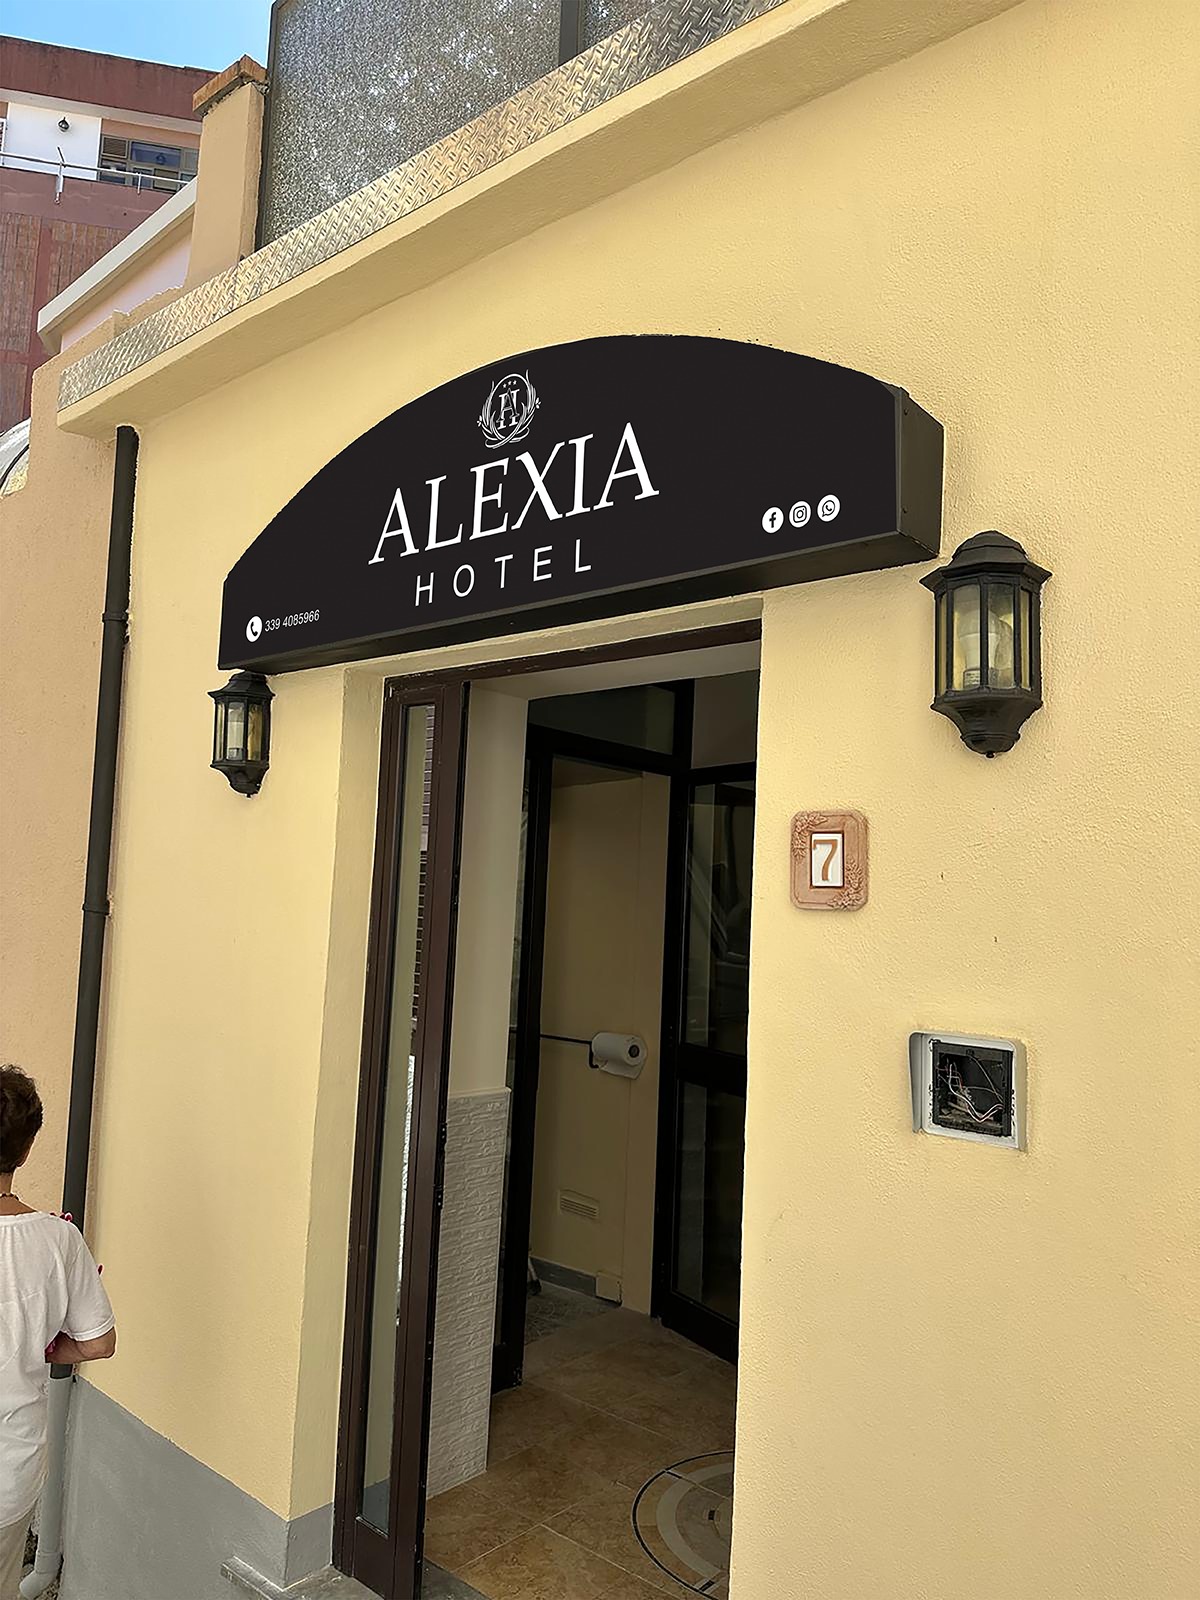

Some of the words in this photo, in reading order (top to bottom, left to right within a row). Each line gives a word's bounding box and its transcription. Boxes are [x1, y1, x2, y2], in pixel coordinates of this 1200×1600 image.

[368, 422, 659, 565] ALEXIA
[414, 538, 592, 607] HOTEL
[264, 618, 281, 632] 339
[282, 609, 320, 628] 4085966
[813, 839, 838, 881] 7
